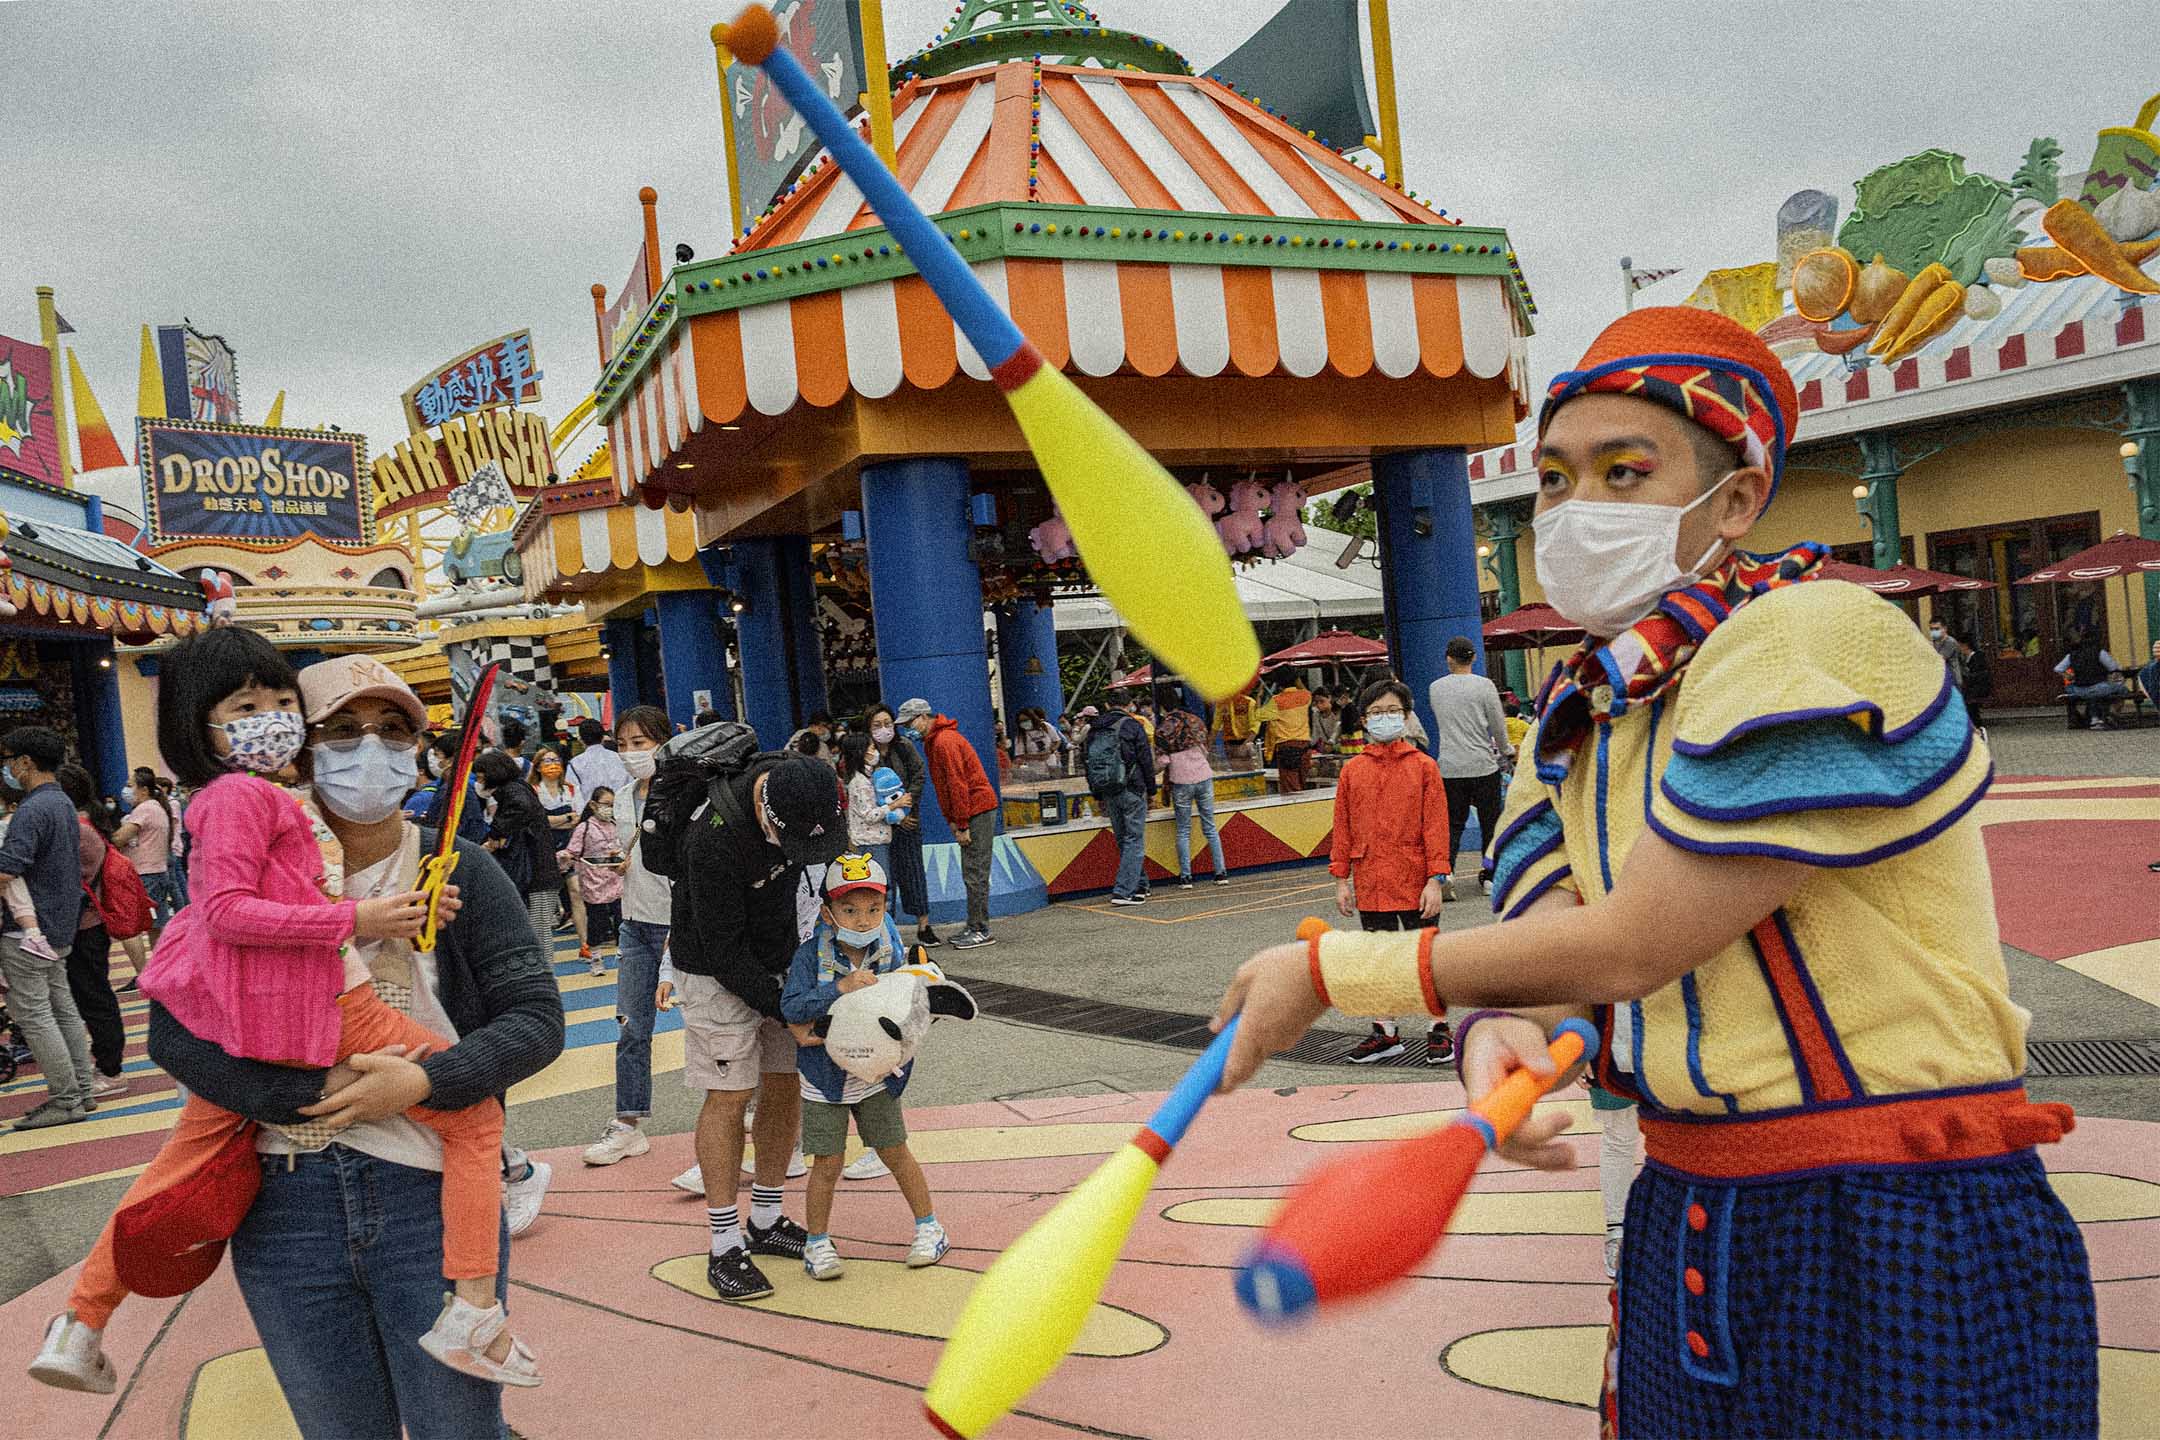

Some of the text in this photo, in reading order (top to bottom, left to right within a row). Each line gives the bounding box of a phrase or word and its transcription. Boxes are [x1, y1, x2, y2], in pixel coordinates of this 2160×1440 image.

[414, 334, 544, 426] 動感快車
[441, 408, 557, 489] RAISER
